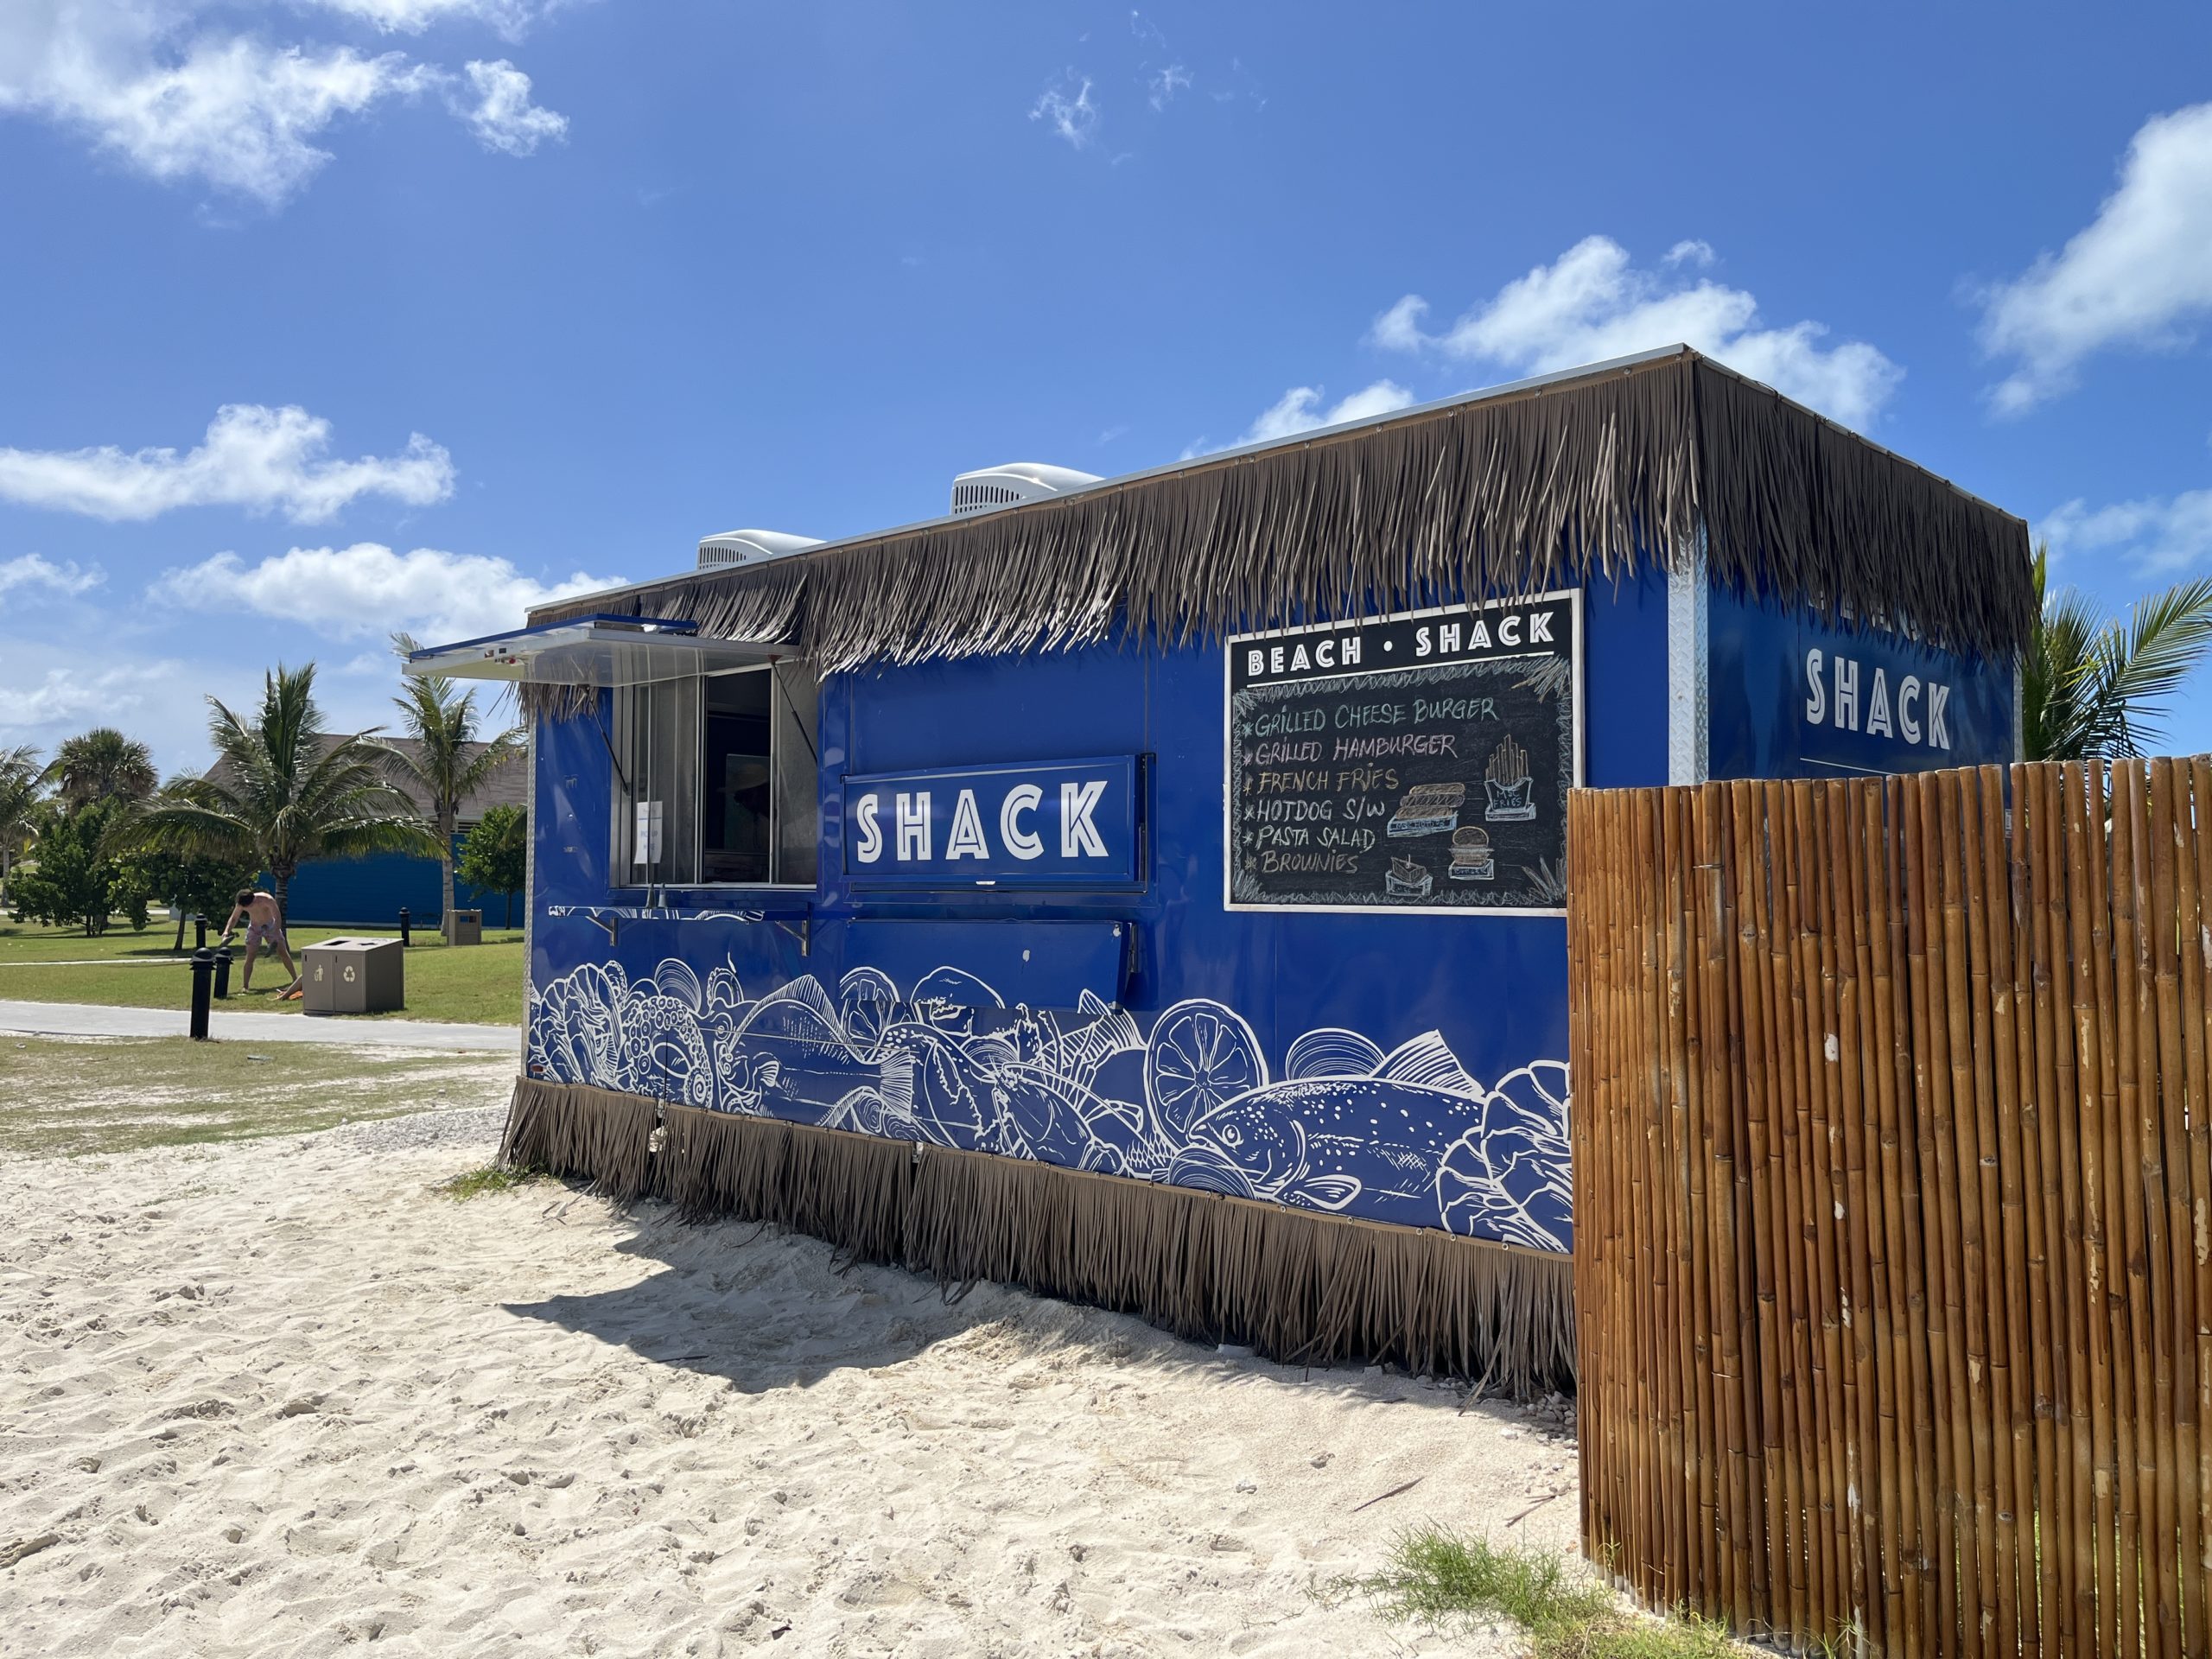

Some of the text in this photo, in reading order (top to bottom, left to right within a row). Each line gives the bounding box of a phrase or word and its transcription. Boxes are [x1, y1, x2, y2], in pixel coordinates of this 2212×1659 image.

[1248, 611, 1554, 677] BEACH SHACK
[1335, 703, 1407, 729] CHEESE
[1413, 696, 1500, 725] BURGER
[1806, 648, 1950, 750] SHACK
[1333, 734, 1458, 761] HAMBURGER
[1256, 769, 1329, 795] FRENCH
[856, 780, 1109, 863] SHACK
[1257, 798, 1333, 822] HOTDOG
[1255, 824, 1376, 854] PASTA SALAD
